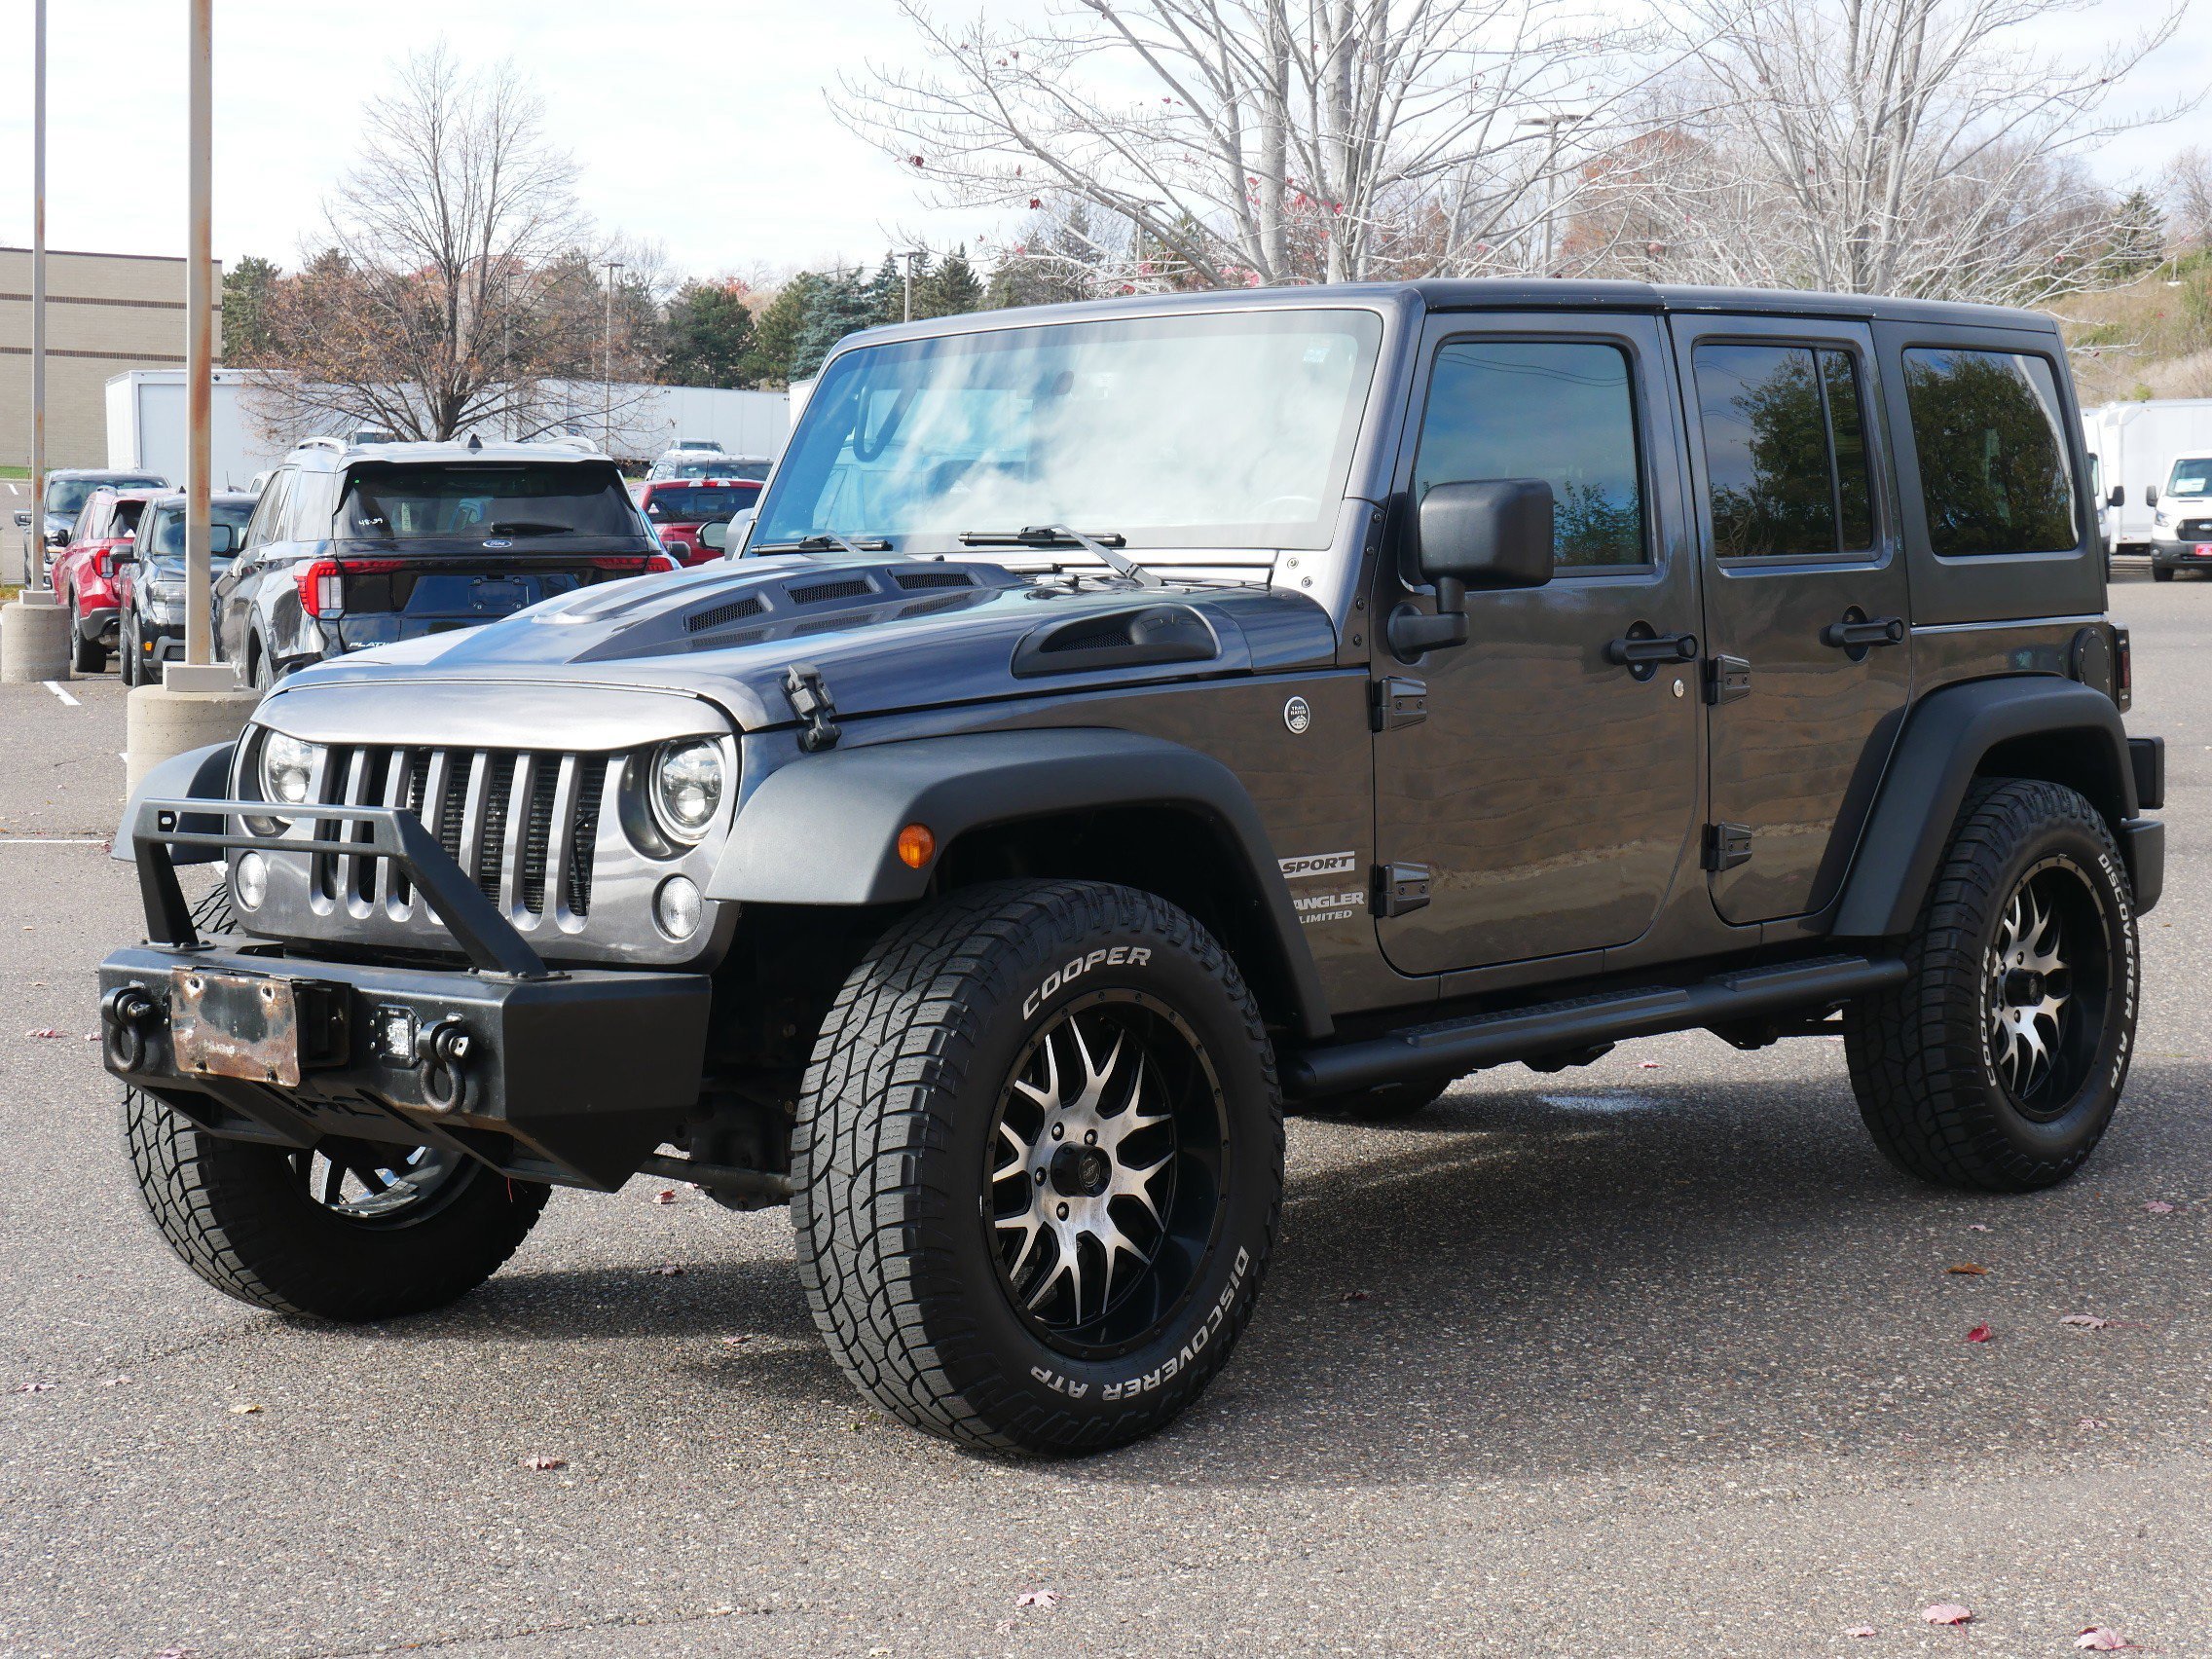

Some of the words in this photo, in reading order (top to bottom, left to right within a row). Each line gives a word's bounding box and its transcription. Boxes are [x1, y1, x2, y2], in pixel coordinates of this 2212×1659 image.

[1283, 855, 1354, 874] SPORT
[1293, 892, 1365, 910] ANGLER
[1299, 909, 1353, 924] LIMITED
[2098, 853, 2134, 1019] DISCOVERER
[1022, 945, 1152, 1020] COOPER
[1980, 946, 1997, 1087] COOPER
[2111, 1031, 2128, 1088] ATP
[1102, 1245, 1250, 1400] DISCOVERER
[1030, 1366, 1088, 1399] ATP
